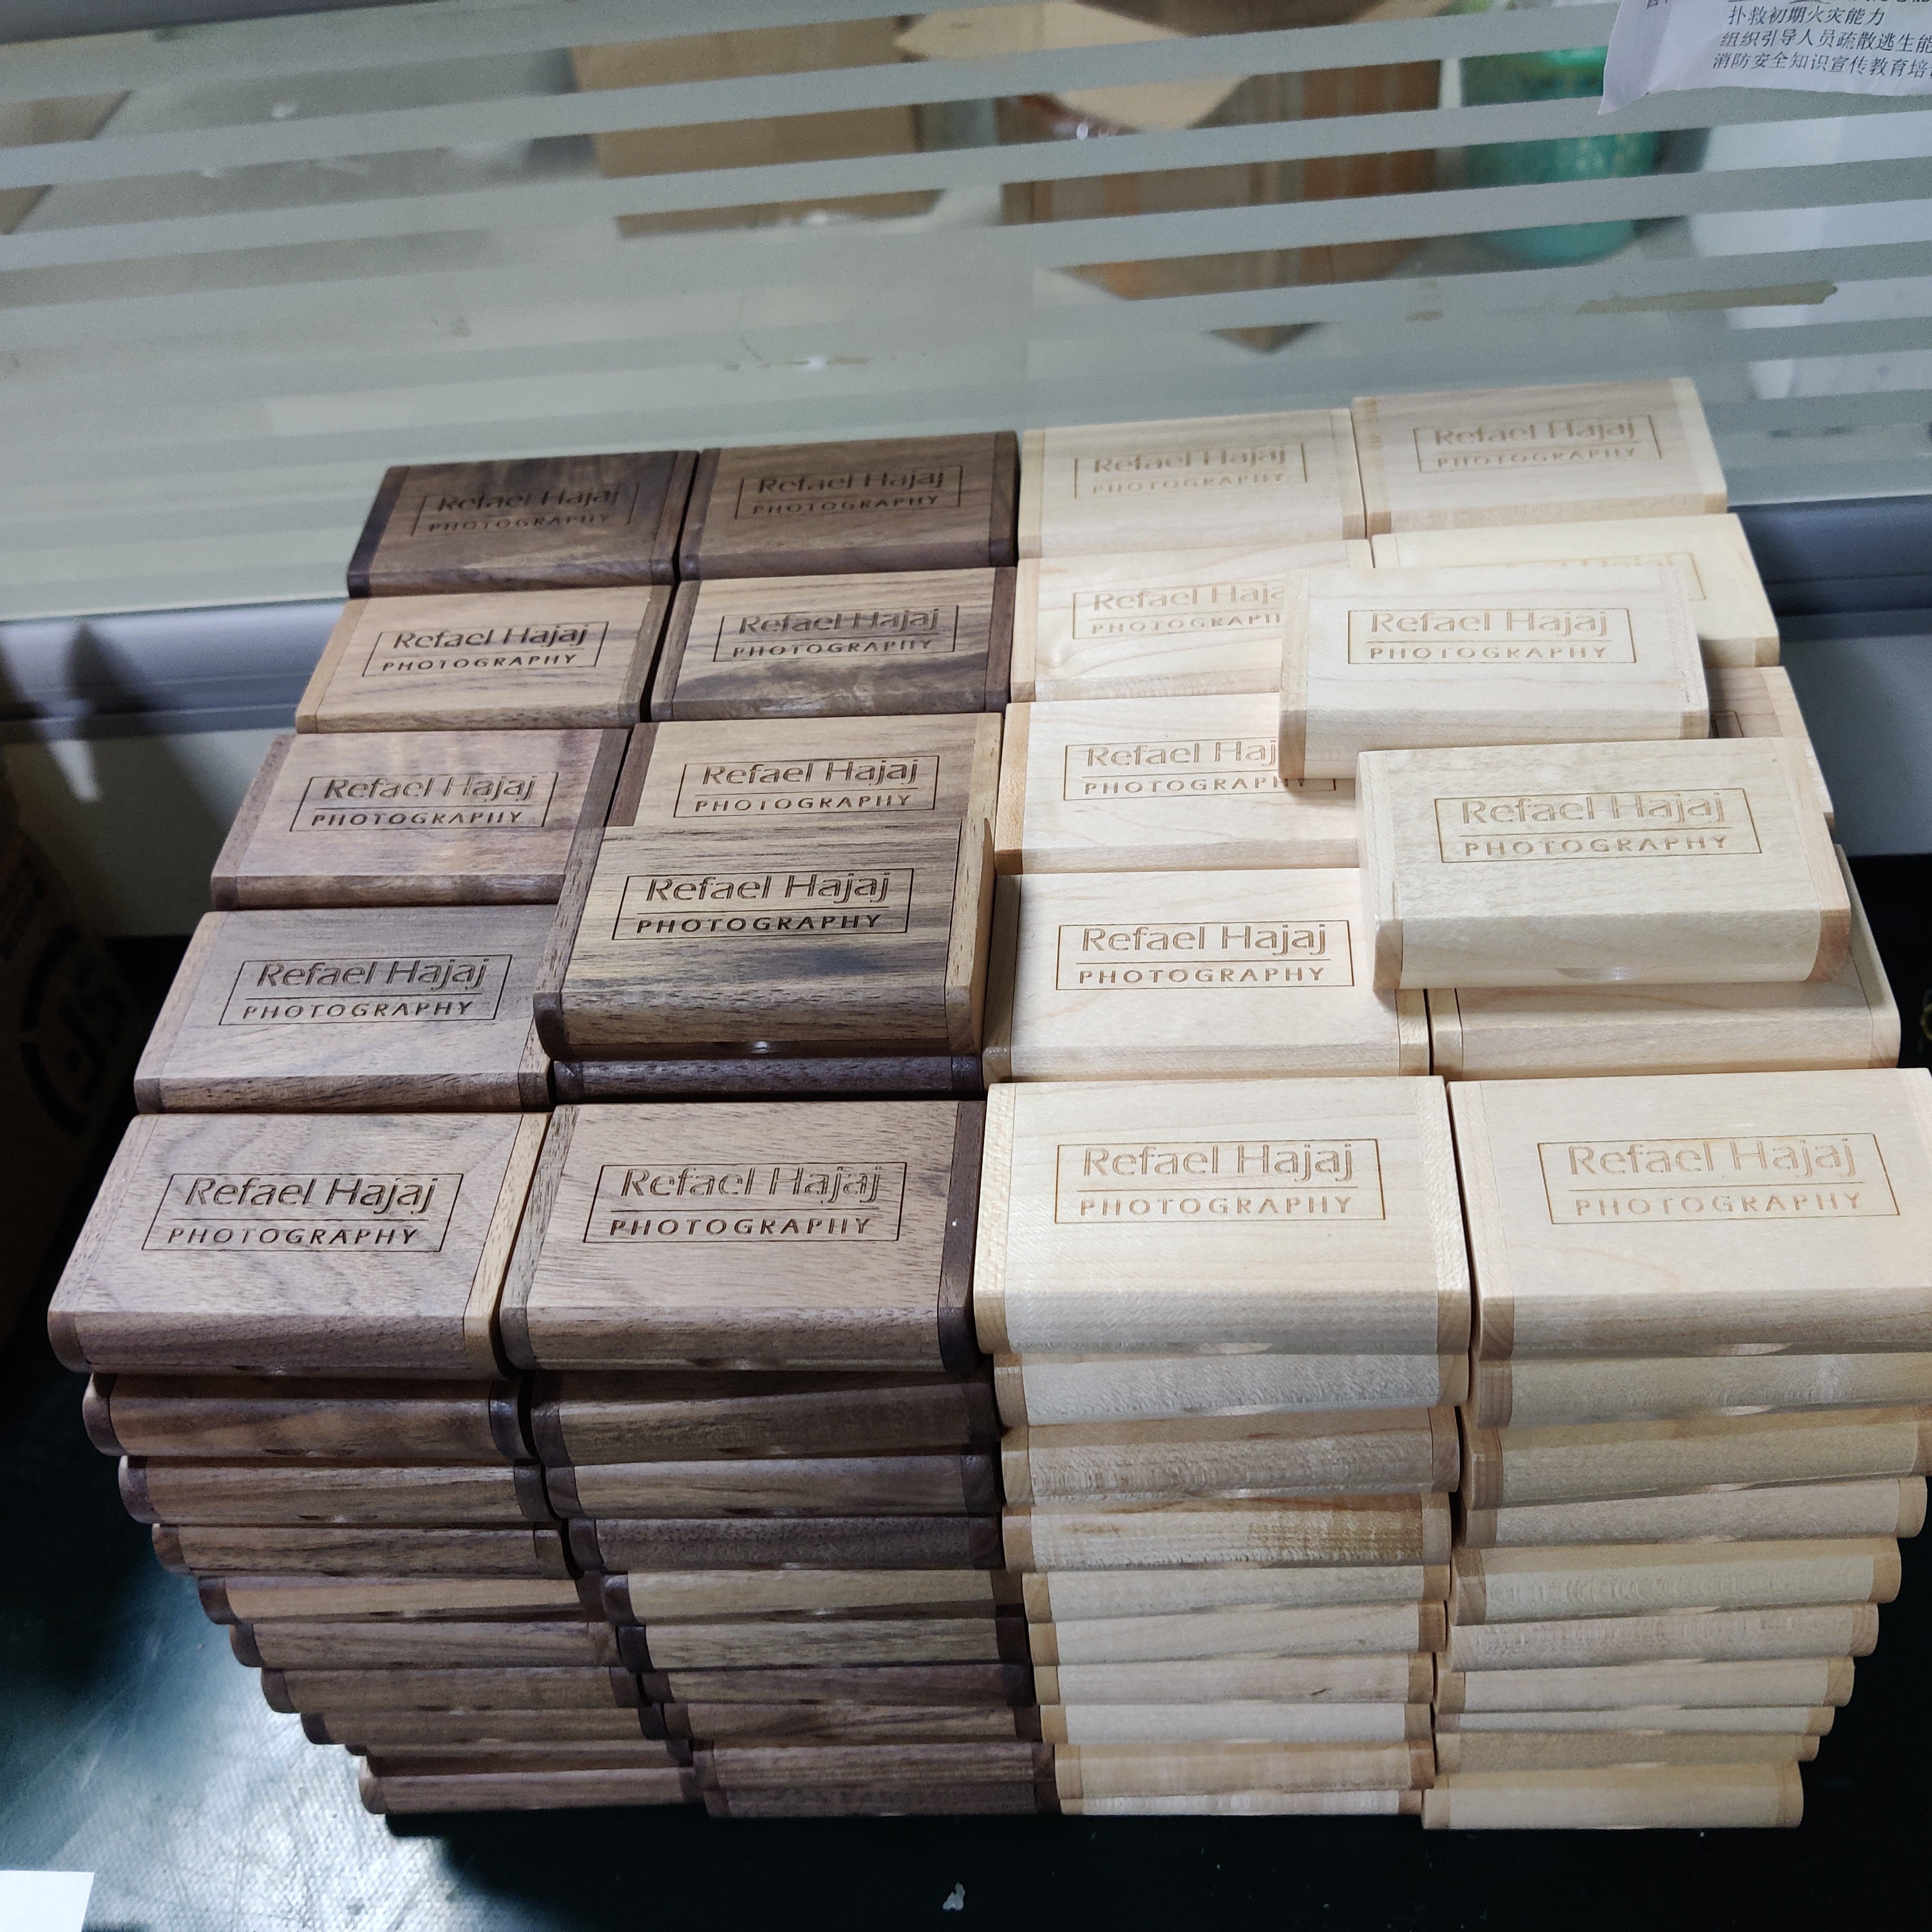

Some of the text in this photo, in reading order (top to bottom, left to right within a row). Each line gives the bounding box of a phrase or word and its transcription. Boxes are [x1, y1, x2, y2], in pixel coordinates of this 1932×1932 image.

[1727, 5, 1886, 27] 扑救初期火灾能力
[1712, 51, 1932, 79] 消防安全知识宣传教育培
[1434, 419, 1636, 446] Refael Hajaj
[1094, 448, 1285, 473] Refael Hajaj
[1437, 447, 1636, 468] PHOTOGRAPHY
[757, 471, 945, 494] Refael Hajaj
[1092, 473, 1283, 495] PHOTOGRAPHY
[437, 487, 621, 512] Refael Hajaj
[752, 495, 939, 515] PHOTOGRAPHY
[429, 515, 611, 533] PHOTOGRAPHY
[1094, 583, 1283, 611] Refael Haja
[739, 609, 940, 634] Refael Hajaj
[1092, 612, 1278, 634] PHOTOGRAPH
[1370, 611, 1607, 636] Refael Hajaj
[393, 625, 590, 649] Refael Hajaj
[732, 639, 933, 658] PHOTOGRAPHY
[383, 654, 578, 672] PHOTOGRAPHY
[1370, 646, 1607, 659] PHOTOGRAPHY
[1087, 740, 1276, 767] Refael Haj
[702, 759, 918, 786] Refael Hajaj
[324, 775, 538, 801] Refael Hajaj
[695, 794, 911, 813] PHOTOGRAPHY
[1462, 792, 1725, 824] Refael Hajaj
[312, 811, 522, 827] PHOTOGRAPHY
[1464, 835, 1728, 856] PHOTOGRAPHY
[646, 873, 891, 904] Refael Hajaj
[636, 914, 882, 934] PHOTOGRAPHY
[1082, 924, 1326, 956] Refael Hajaj
[257, 959, 489, 990] Refael Hajaj
[1079, 967, 1324, 984] PHOTOGRAPHY
[243, 1001, 473, 1019] PHOTOGRAPHY
[1084, 1143, 1352, 1182] Refael Hajaj
[1568, 1138, 1856, 1178] Refael Hajaj
[185, 1177, 439, 1215] Refael Hajaj
[621, 1166, 882, 1204] Refael Hajaj
[1081, 1196, 1352, 1216] PHOTOGRAPHY
[1576, 1191, 1861, 1216] PHOTOGRAPHY
[168, 1227, 418, 1245] PHOTOGRAPHY
[610, 1218, 871, 1236] PHOTOGRAPHY
